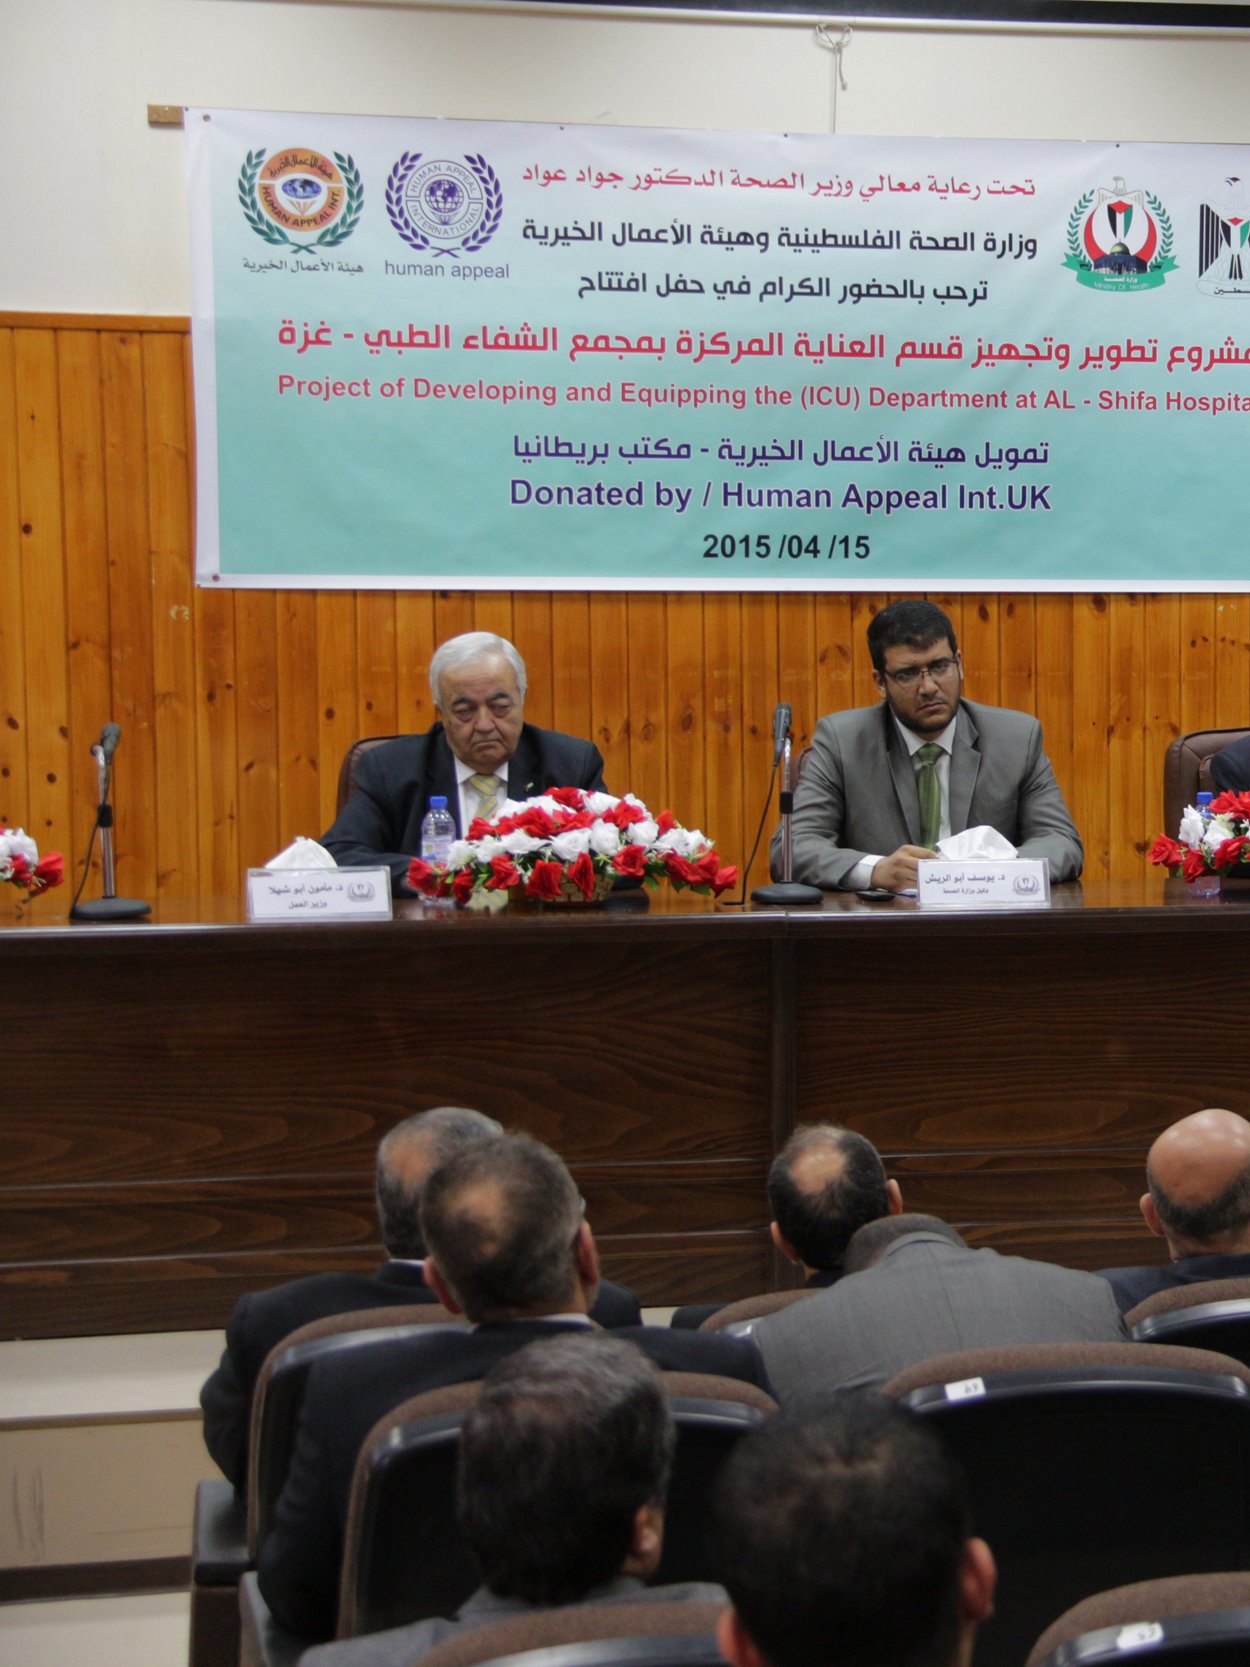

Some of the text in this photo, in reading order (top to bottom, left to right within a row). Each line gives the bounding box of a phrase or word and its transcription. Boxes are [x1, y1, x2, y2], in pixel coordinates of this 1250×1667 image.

[410, 164, 477, 194] HUMAN APPEAL
[523, 164, 1035, 202] تحت رعاية معالي وزير الصحة الدكتور جواد عواد
[262, 186, 291, 224] HUMAN
[292, 209, 331, 227] APPEAL
[410, 205, 480, 236] INTERNATIONAL
[523, 218, 1037, 260] وزارة الصحة الفلسطينية وهيئة الأعمال الخيرية
[243, 258, 364, 276] هيئة الأعمال الخيرية
[385, 260, 509, 281] human appeal
[578, 271, 988, 307] ترحب بالحضور الكرام في حفل افتتاح
[279, 320, 332, 354] غزة
[364, 324, 450, 355] الطبي
[463, 322, 557, 351] الشفاء
[569, 334, 665, 362] بمجمع
[676, 330, 784, 364] المركزة
[794, 332, 885, 364] العناية
[896, 336, 962, 367] قسم
[971, 338, 1071, 369] وتجهيز
[1079, 338, 1159, 371] تطوير
[278, 375, 371, 401] Project
[379, 377, 405, 397] of
[413, 378, 557, 406] Developing
[566, 383, 612, 402] and
[622, 382, 747, 409] Equipping
[755, 386, 793, 405] the
[801, 386, 861, 411] (ICU)
[869, 386, 1007, 411] Department
[1015, 391, 1038, 409] at
[1044, 390, 1075, 410] AL
[1098, 390, 1158, 411] Shifa
[514, 435, 609, 465] بريطانيا
[618, 437, 691, 466] مكتب
[718, 438, 803, 468] الخيرية
[813, 435, 899, 466] الأعمال
[908, 441, 966, 469] هيئة
[975, 442, 1049, 471] تمويل
[511, 480, 644, 506] Donated
[656, 481, 693, 514] by
[722, 482, 832, 509] Human
[840, 484, 948, 514] Appeal
[958, 484, 1051, 511] Int.UK
